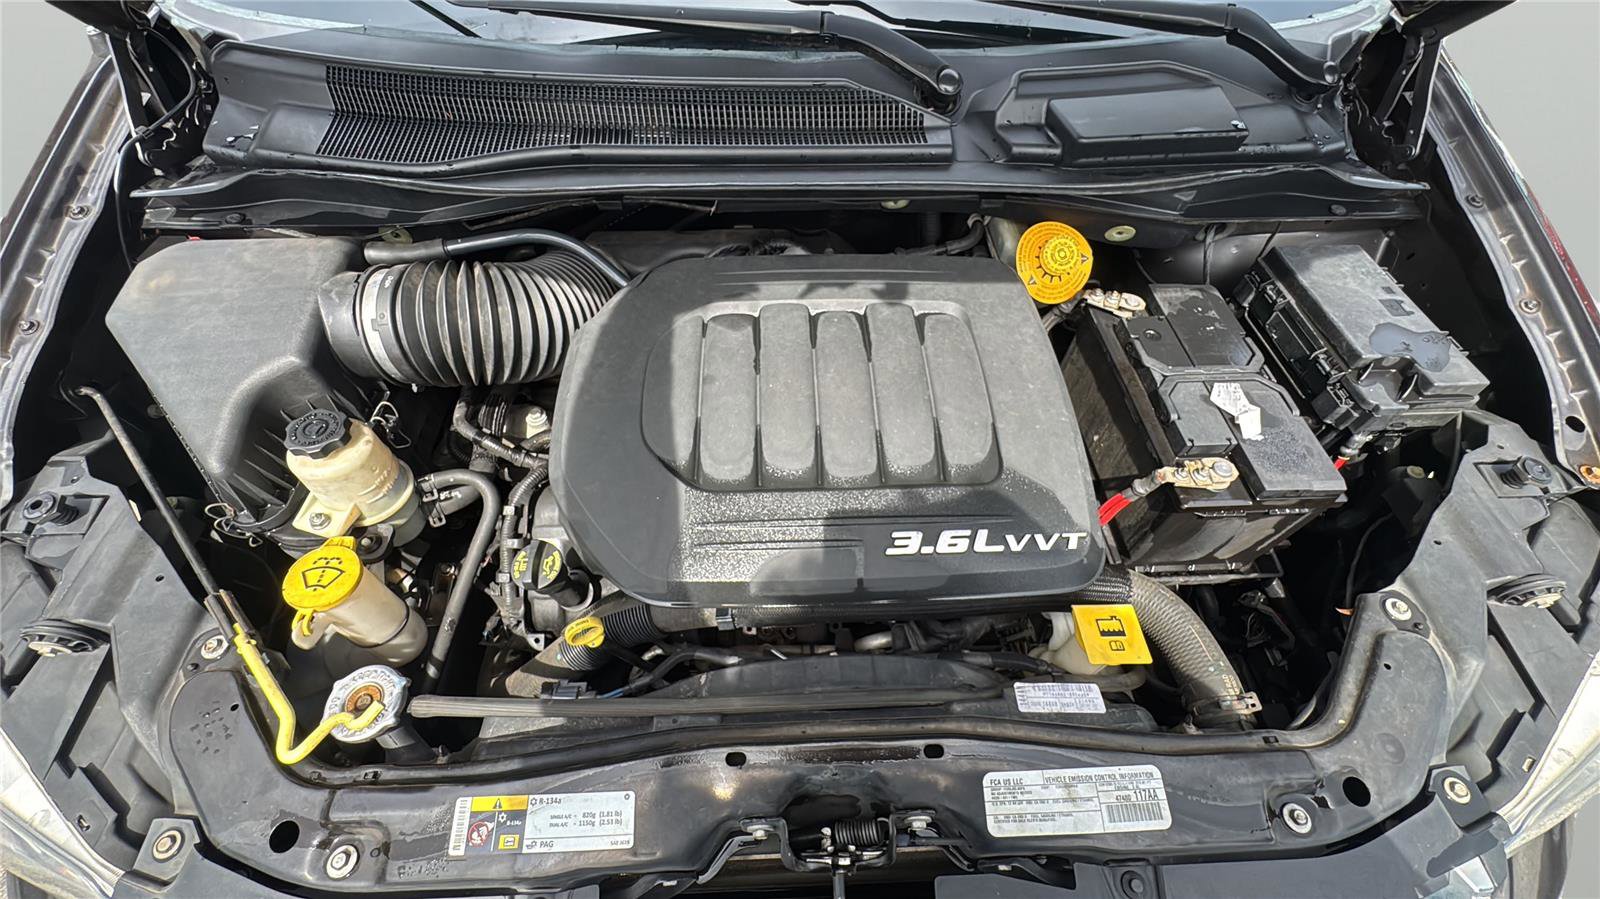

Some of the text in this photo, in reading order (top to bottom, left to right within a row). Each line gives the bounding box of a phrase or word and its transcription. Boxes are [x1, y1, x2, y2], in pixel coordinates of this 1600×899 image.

[1044, 772, 1154, 784] VEHICLE EMISSION CONTROL INFORMATION
[1133, 789, 1159, 800] 117AA
[538, 797, 562, 805] R-134a
[579, 819, 596, 827] 1150g
